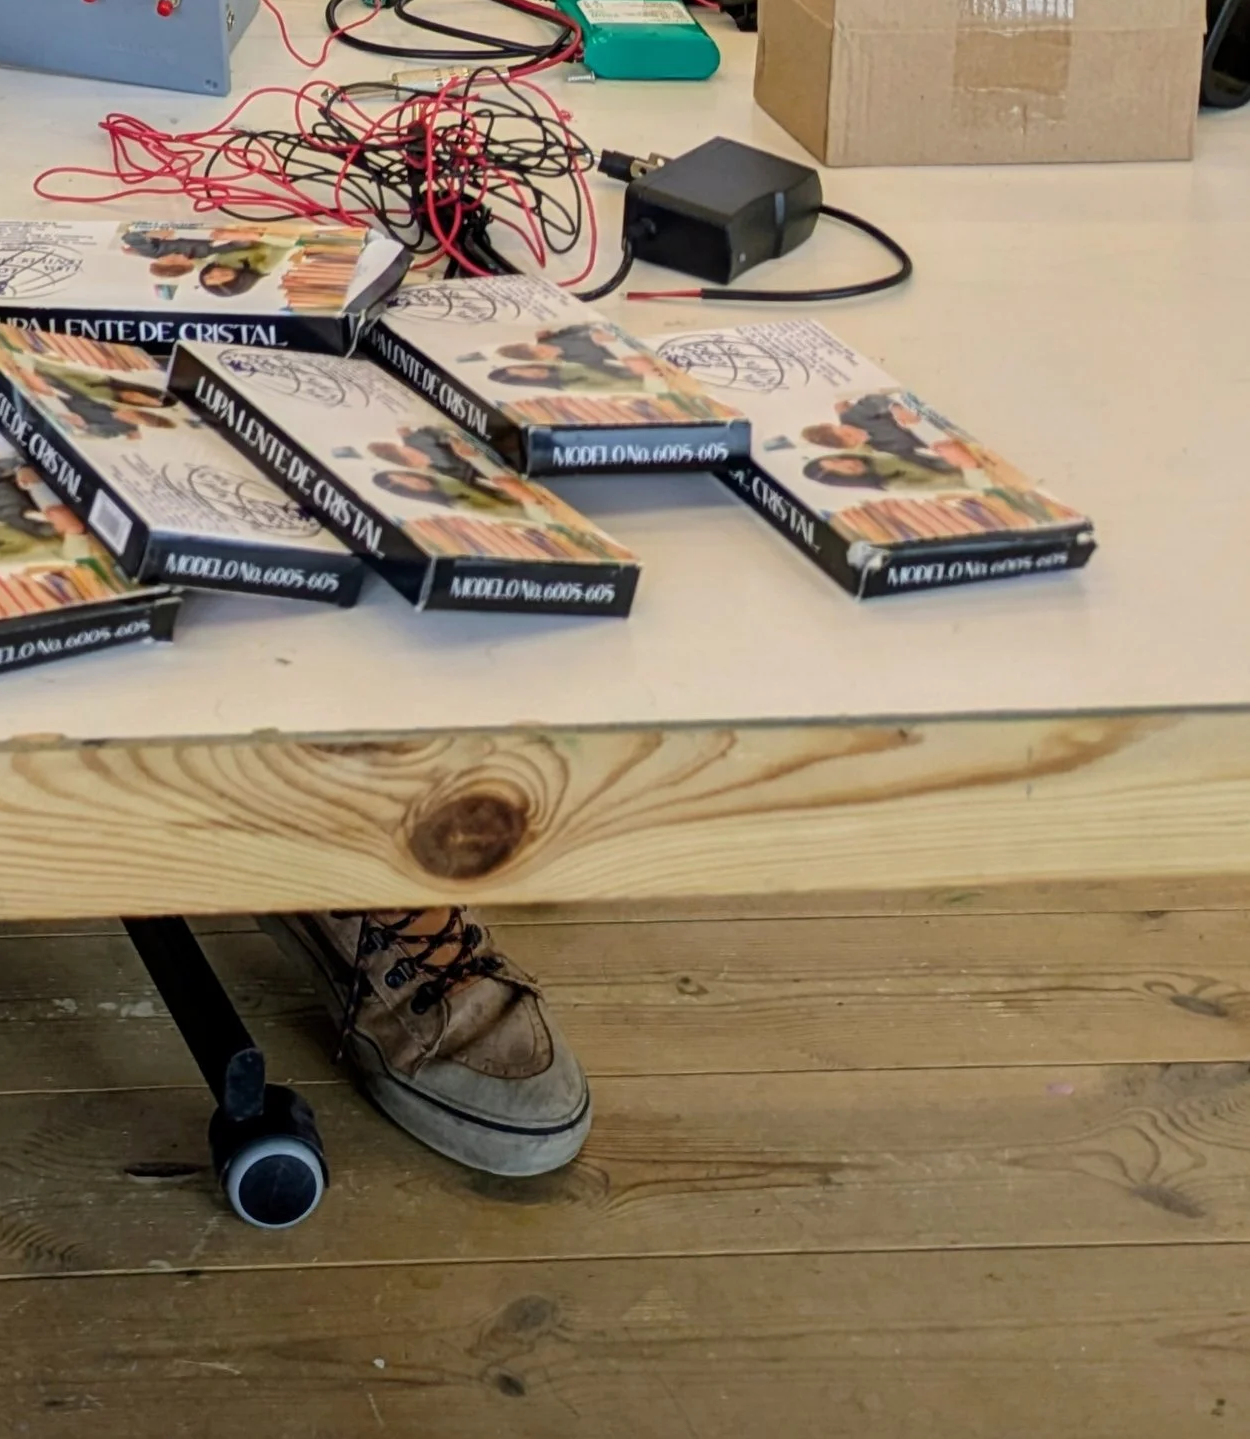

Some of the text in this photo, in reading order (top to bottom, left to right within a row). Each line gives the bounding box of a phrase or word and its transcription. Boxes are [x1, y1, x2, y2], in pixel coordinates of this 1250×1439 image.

[139, 320, 174, 342] DE
[178, 322, 288, 347] CRISTAL
[387, 339, 424, 386] LENTE
[421, 367, 441, 400] DE
[439, 382, 492, 441] CRISTAL
[9, 412, 34, 447] DE
[28, 432, 82, 503] CRISTAL
[195, 375, 235, 428] LUPA
[235, 408, 292, 475] LENTE
[287, 456, 317, 496] DE
[313, 479, 386, 560] CRISTAL
[553, 444, 626, 467] MODELO
[751, 475, 821, 554] CRISTAL
[165, 552, 238, 580] MODELO
[887, 562, 964, 586] MODELO
[450, 575, 519, 600] MODELO
